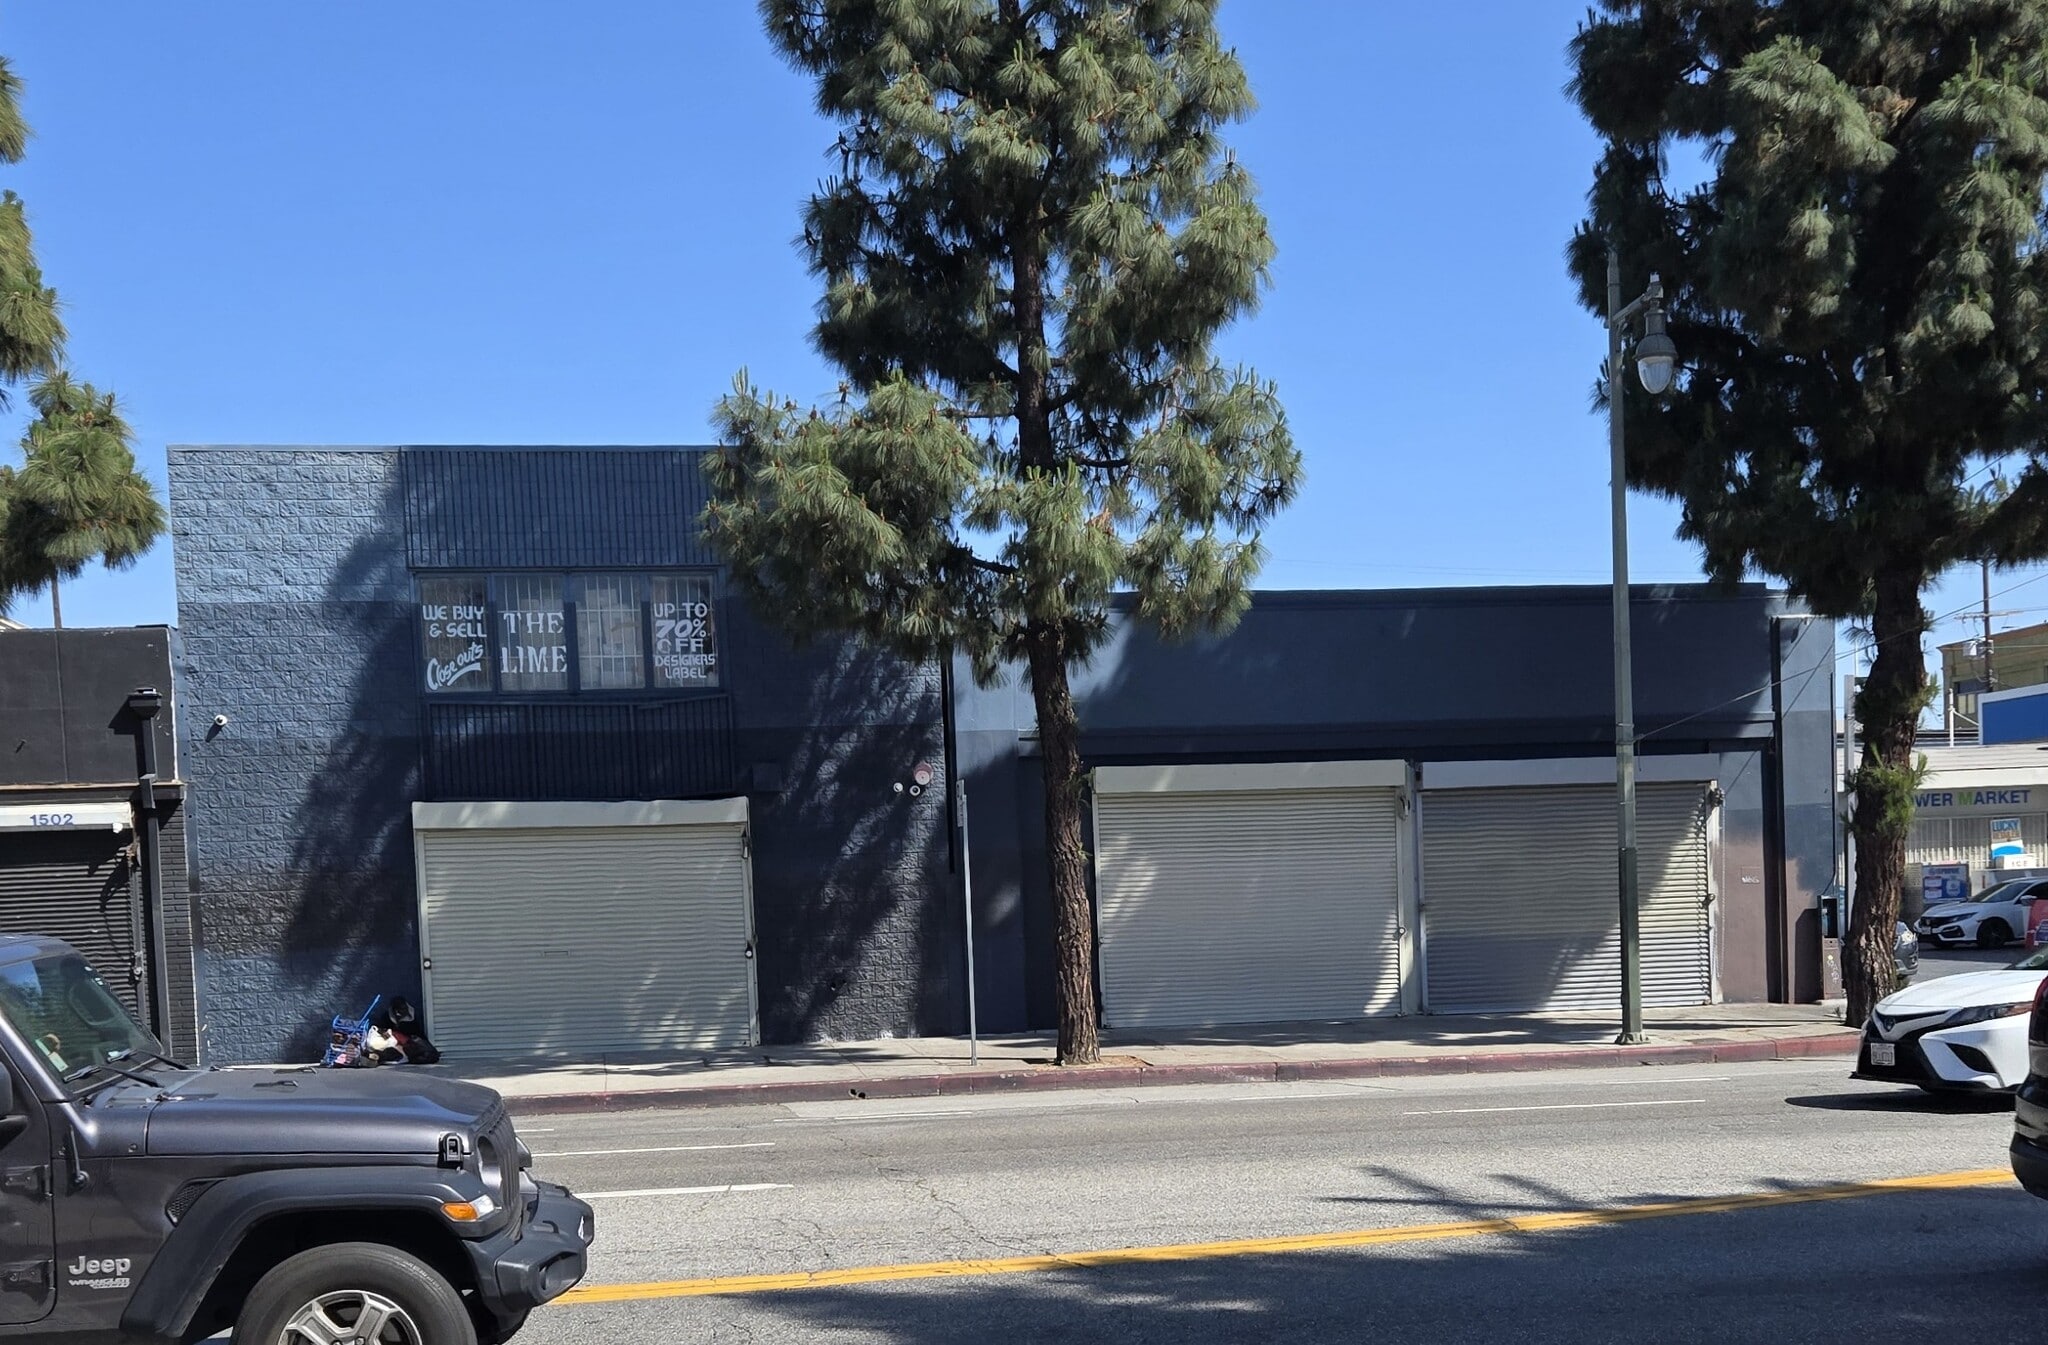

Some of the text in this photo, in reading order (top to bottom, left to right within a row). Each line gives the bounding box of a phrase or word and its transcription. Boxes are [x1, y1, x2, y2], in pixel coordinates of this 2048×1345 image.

[422, 604, 484, 621] WE BUY
[653, 602, 708, 618] UP TO
[429, 622, 488, 638] & SELL
[503, 612, 565, 634] THE
[655, 618, 707, 638] 70%
[656, 637, 704, 654] OFF
[500, 645, 568, 674] LIME
[654, 653, 716, 667] DESIGNERS
[664, 667, 707, 679] LABEL
[1911, 789, 2031, 808] WER MARKET
[29, 813, 74, 827] 1502
[68, 1255, 131, 1276] Jeep
